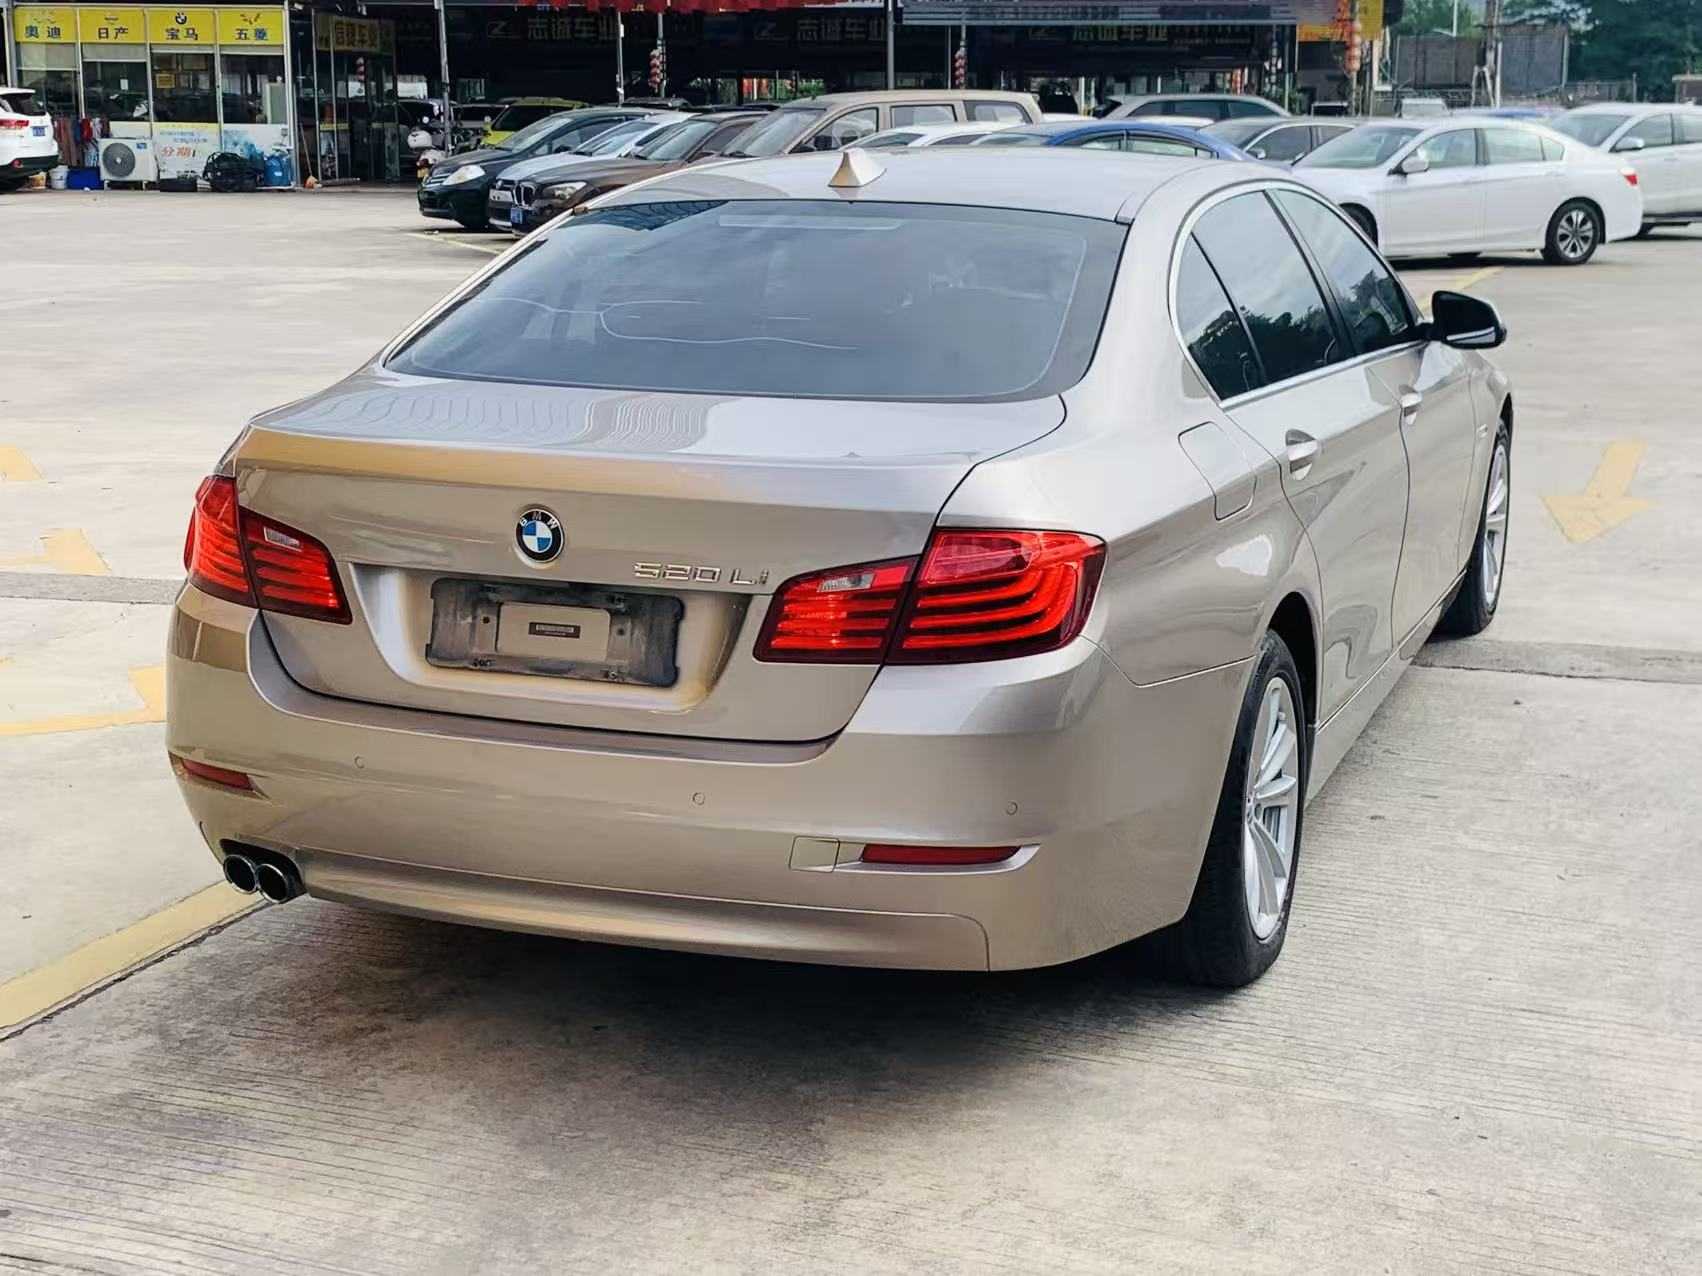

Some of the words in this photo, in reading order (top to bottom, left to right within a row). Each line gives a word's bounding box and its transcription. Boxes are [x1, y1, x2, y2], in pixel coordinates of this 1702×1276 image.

[25, 25, 61, 39] 奥迪
[98, 27, 129, 40] 日产
[165, 27, 198, 41] 宝马
[527, 16, 618, 40] 志诚车业
[519, 510, 559, 530] BMW
[633, 562, 721, 583] 520
